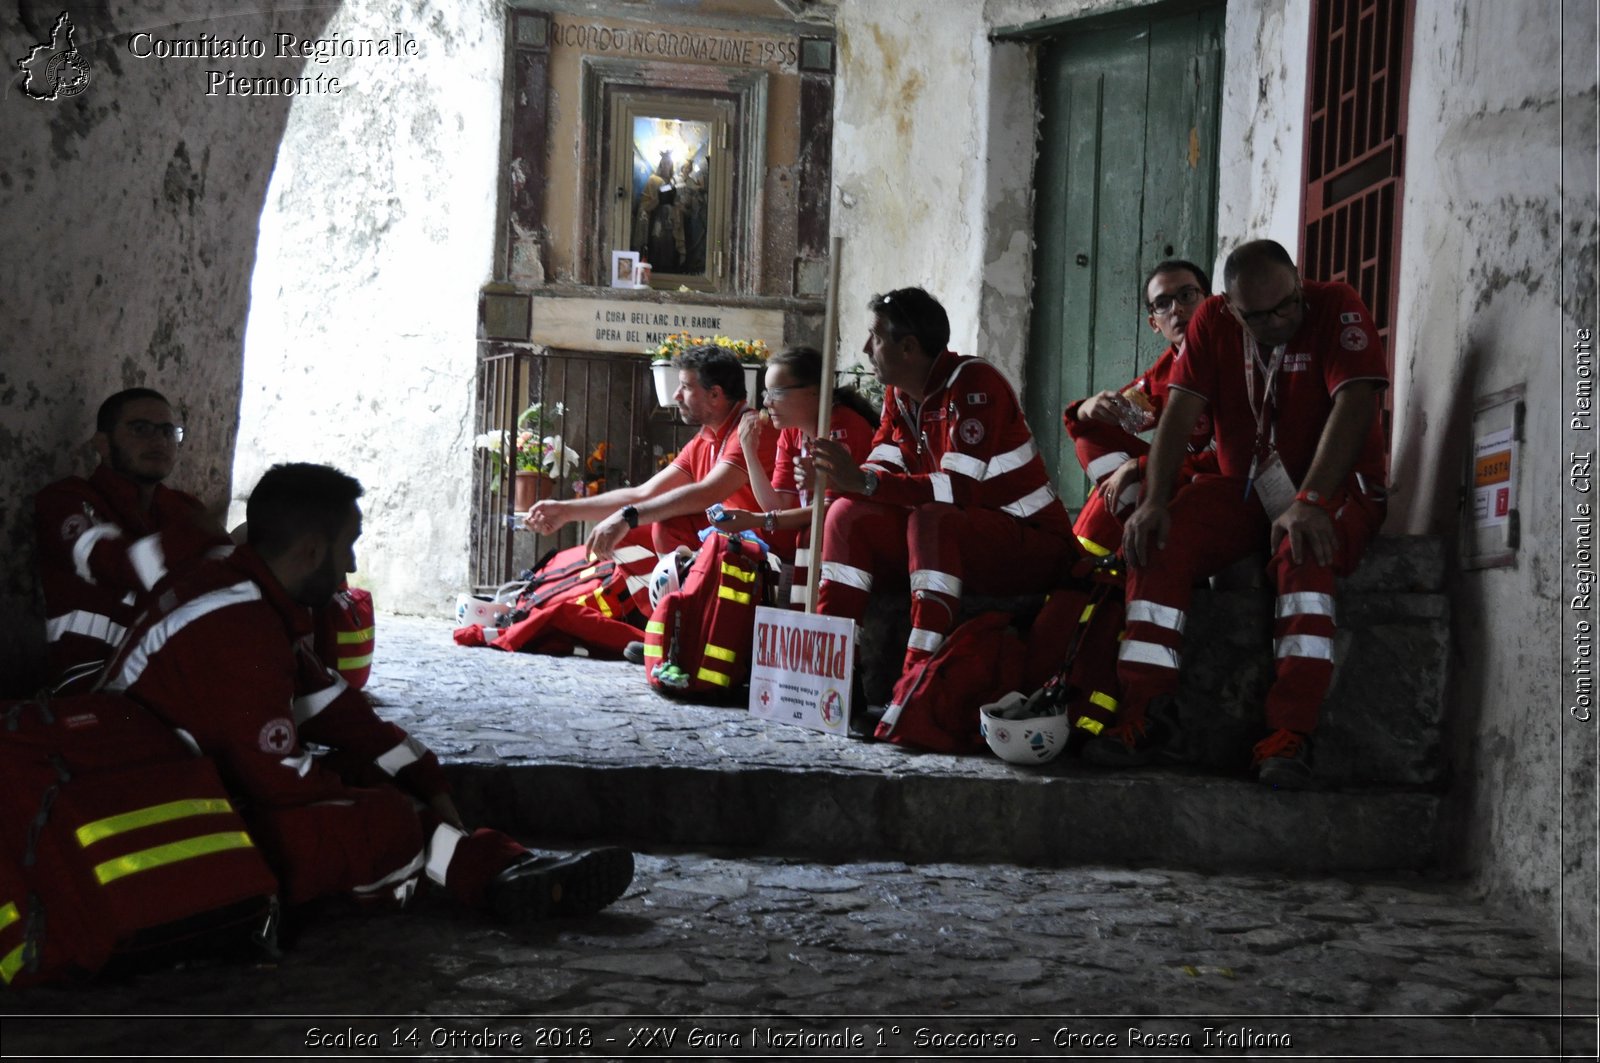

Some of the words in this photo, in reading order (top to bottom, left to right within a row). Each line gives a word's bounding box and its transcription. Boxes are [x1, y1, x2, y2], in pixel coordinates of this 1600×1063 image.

[628, 31, 753, 64] INCORONAZIONE
[595, 309, 601, 322] A
[606, 311, 625, 322] CURA
[691, 316, 721, 330] BARONE
[596, 328, 622, 342] OPERA
[756, 623, 848, 680] PIEMONTE
